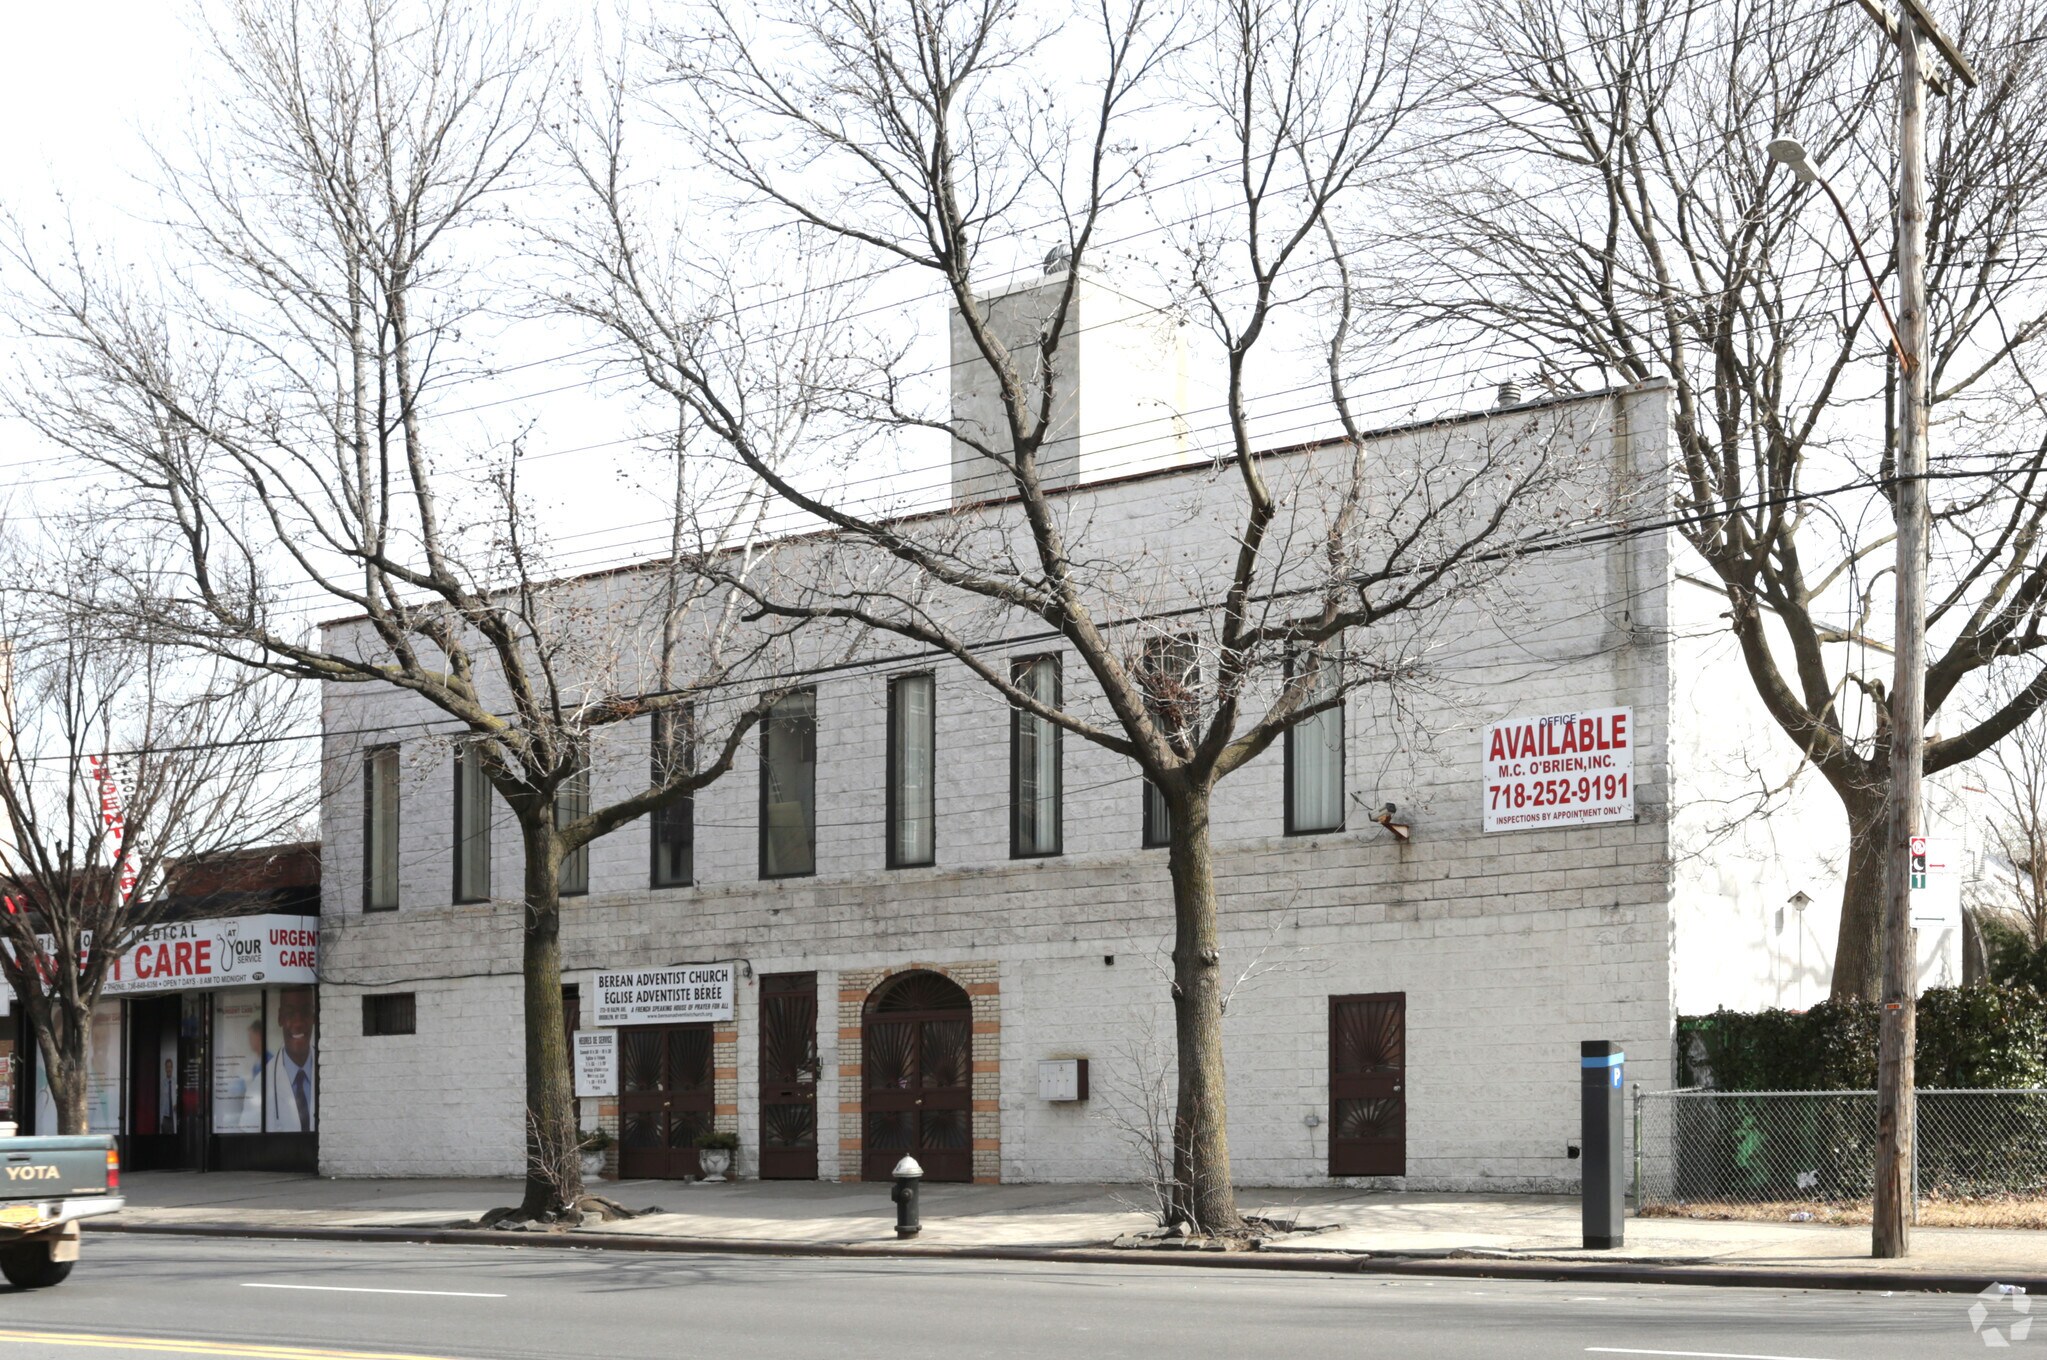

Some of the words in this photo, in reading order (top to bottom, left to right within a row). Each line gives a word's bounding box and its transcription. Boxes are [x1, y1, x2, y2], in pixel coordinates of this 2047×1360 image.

[1539, 713, 1577, 728] OFFICE
[1489, 714, 1627, 762] AVAILABLE
[1498, 763, 1526, 778] M.C.
[1489, 773, 1628, 811] 718-252-9191
[1496, 813, 1540, 825] INSPECTIONS
[1542, 812, 1551, 821] BY
[1552, 808, 1602, 820] APPOINTMENT
[1603, 806, 1622, 815] ONLY
[227, 929, 236, 937] AT
[135, 940, 211, 979] CARE
[237, 954, 262, 964] SERVICE
[279, 950, 315, 967] CARE
[163, 979, 177, 987] OPEN
[182, 977, 196, 985] DAYS
[204, 975, 213, 984] AM
[221, 974, 247, 983] MIDNIGHT
[599, 974, 633, 988] BEREAN
[636, 971, 686, 986] ADVENTIST
[689, 969, 728, 983] CHURCH
[605, 988, 633, 1004] ÉGLISE
[636, 988, 690, 1003] ADVENTISTE
[694, 984, 722, 1000] BÉRÉE
[1614, 1067, 1621, 1086] P
[5, 1166, 60, 1180] YOTA
